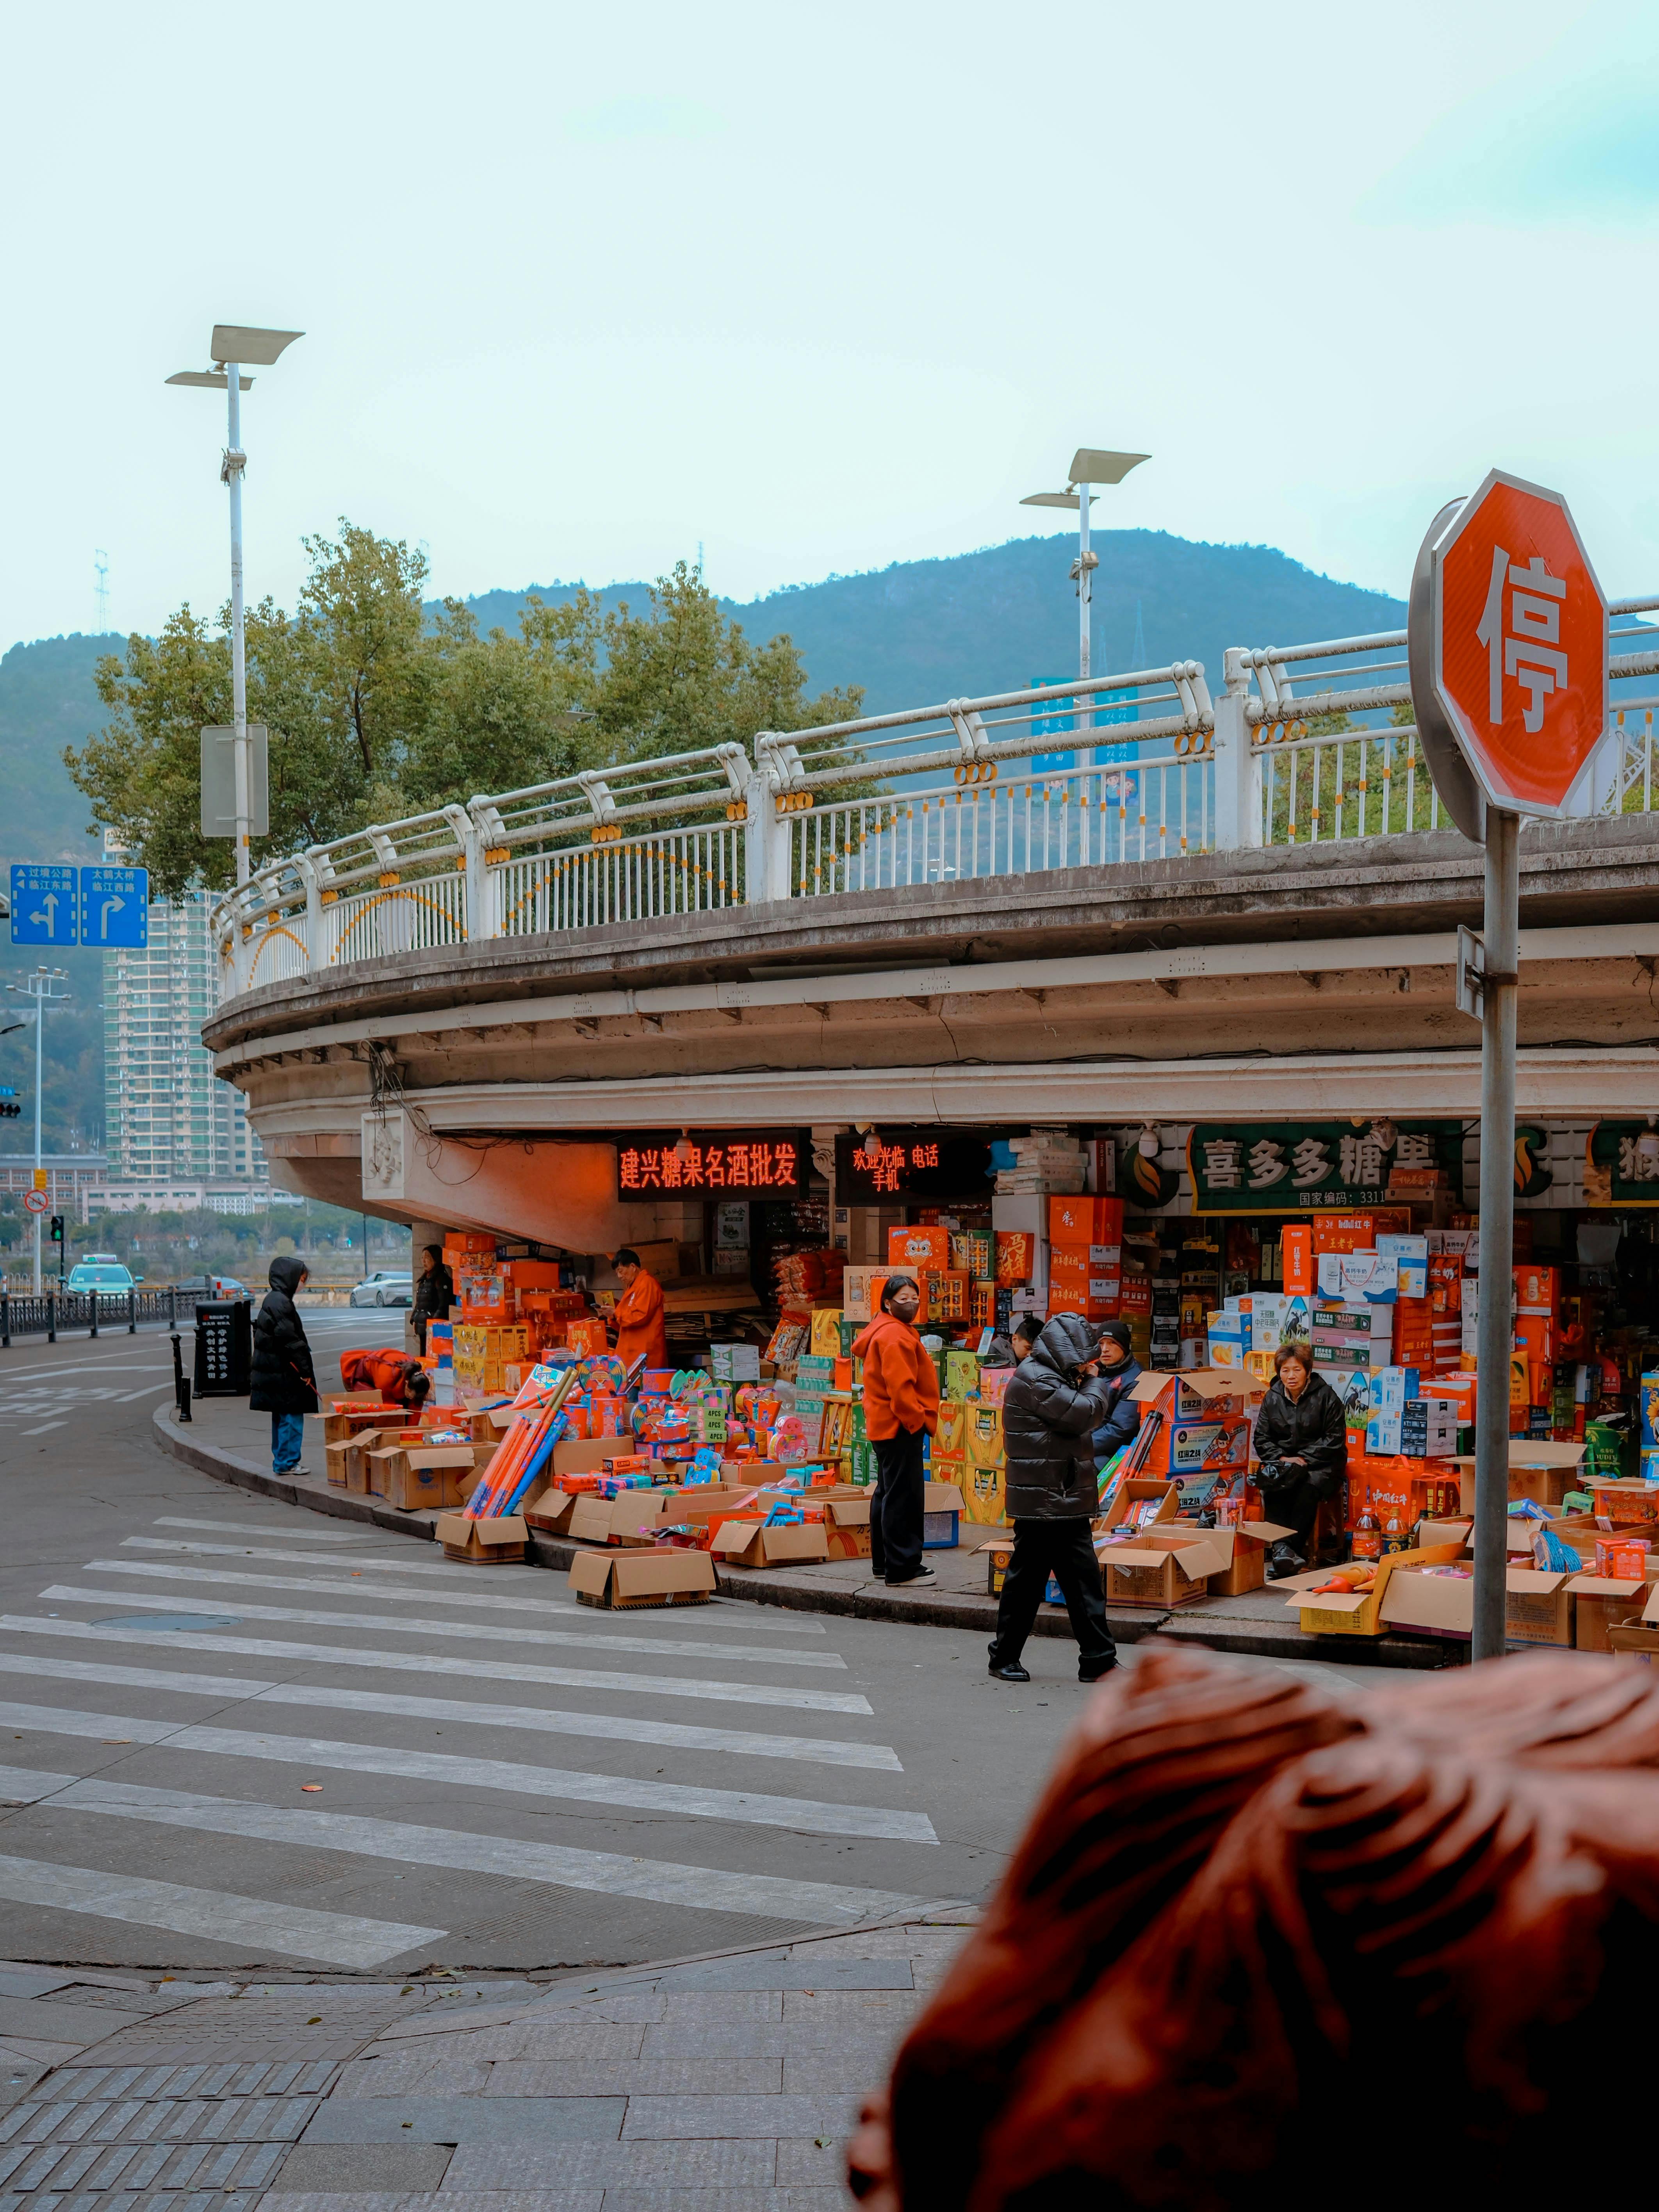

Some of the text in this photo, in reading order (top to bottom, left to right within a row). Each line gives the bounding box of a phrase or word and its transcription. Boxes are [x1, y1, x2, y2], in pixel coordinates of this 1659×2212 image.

[1476, 544, 1568, 733] 停
[29, 868, 72, 878] 过境公路
[92, 870, 135, 880] 太鹤大桥
[29, 880, 72, 891] 临江东路
[92, 882, 135, 893] 临江西路
[912, 1144, 939, 1168] 电话
[620, 1143, 796, 1188] 建兴糖果名酒批发
[872, 1169, 899, 1192] 手机
[1329, 1237, 1353, 1249] 王老吉
[1181, 1399, 1201, 1408] 红海之战
[1178, 1449, 1201, 1458] 红海之战
[1372, 1488, 1407, 1510] 中国红牛
